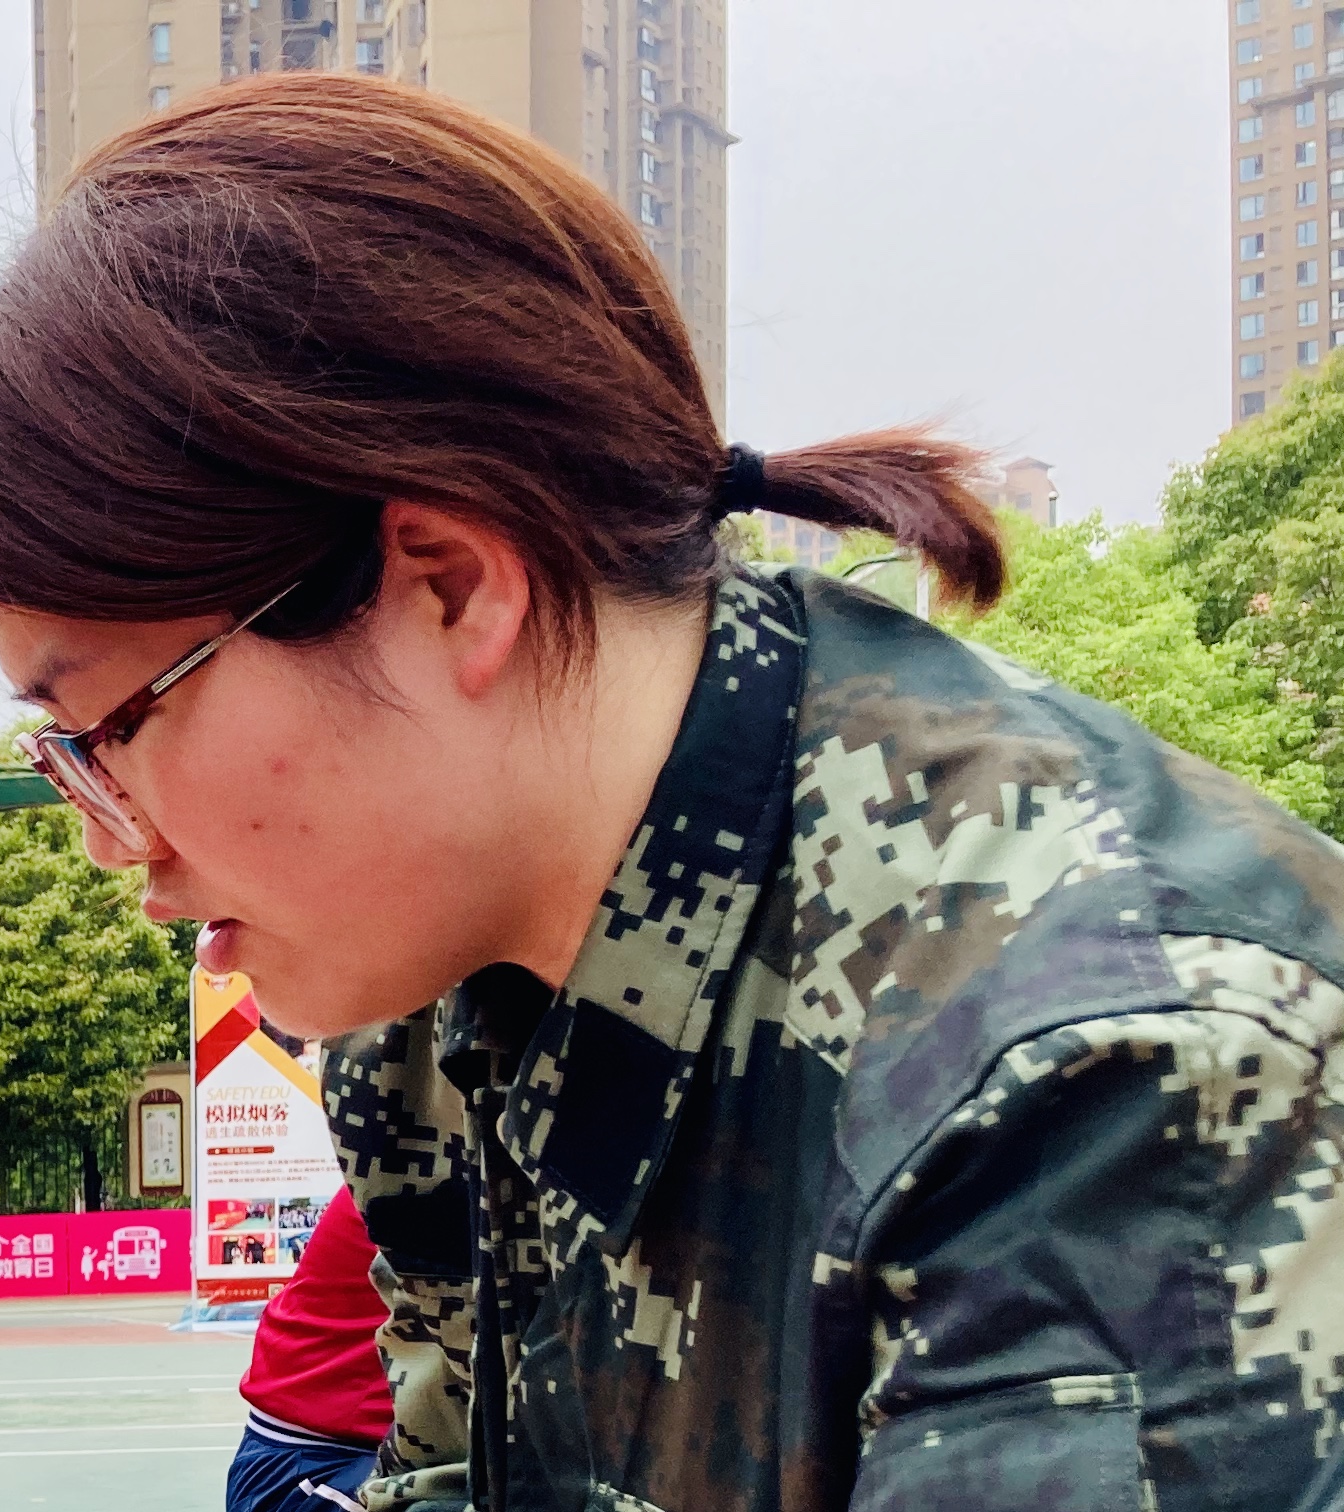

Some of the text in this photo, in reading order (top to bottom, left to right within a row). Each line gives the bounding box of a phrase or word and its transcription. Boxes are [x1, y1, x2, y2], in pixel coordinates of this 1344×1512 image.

[207, 1085, 291, 1101] SAFETY EDU
[206, 1102, 289, 1123] 模拟烟雾
